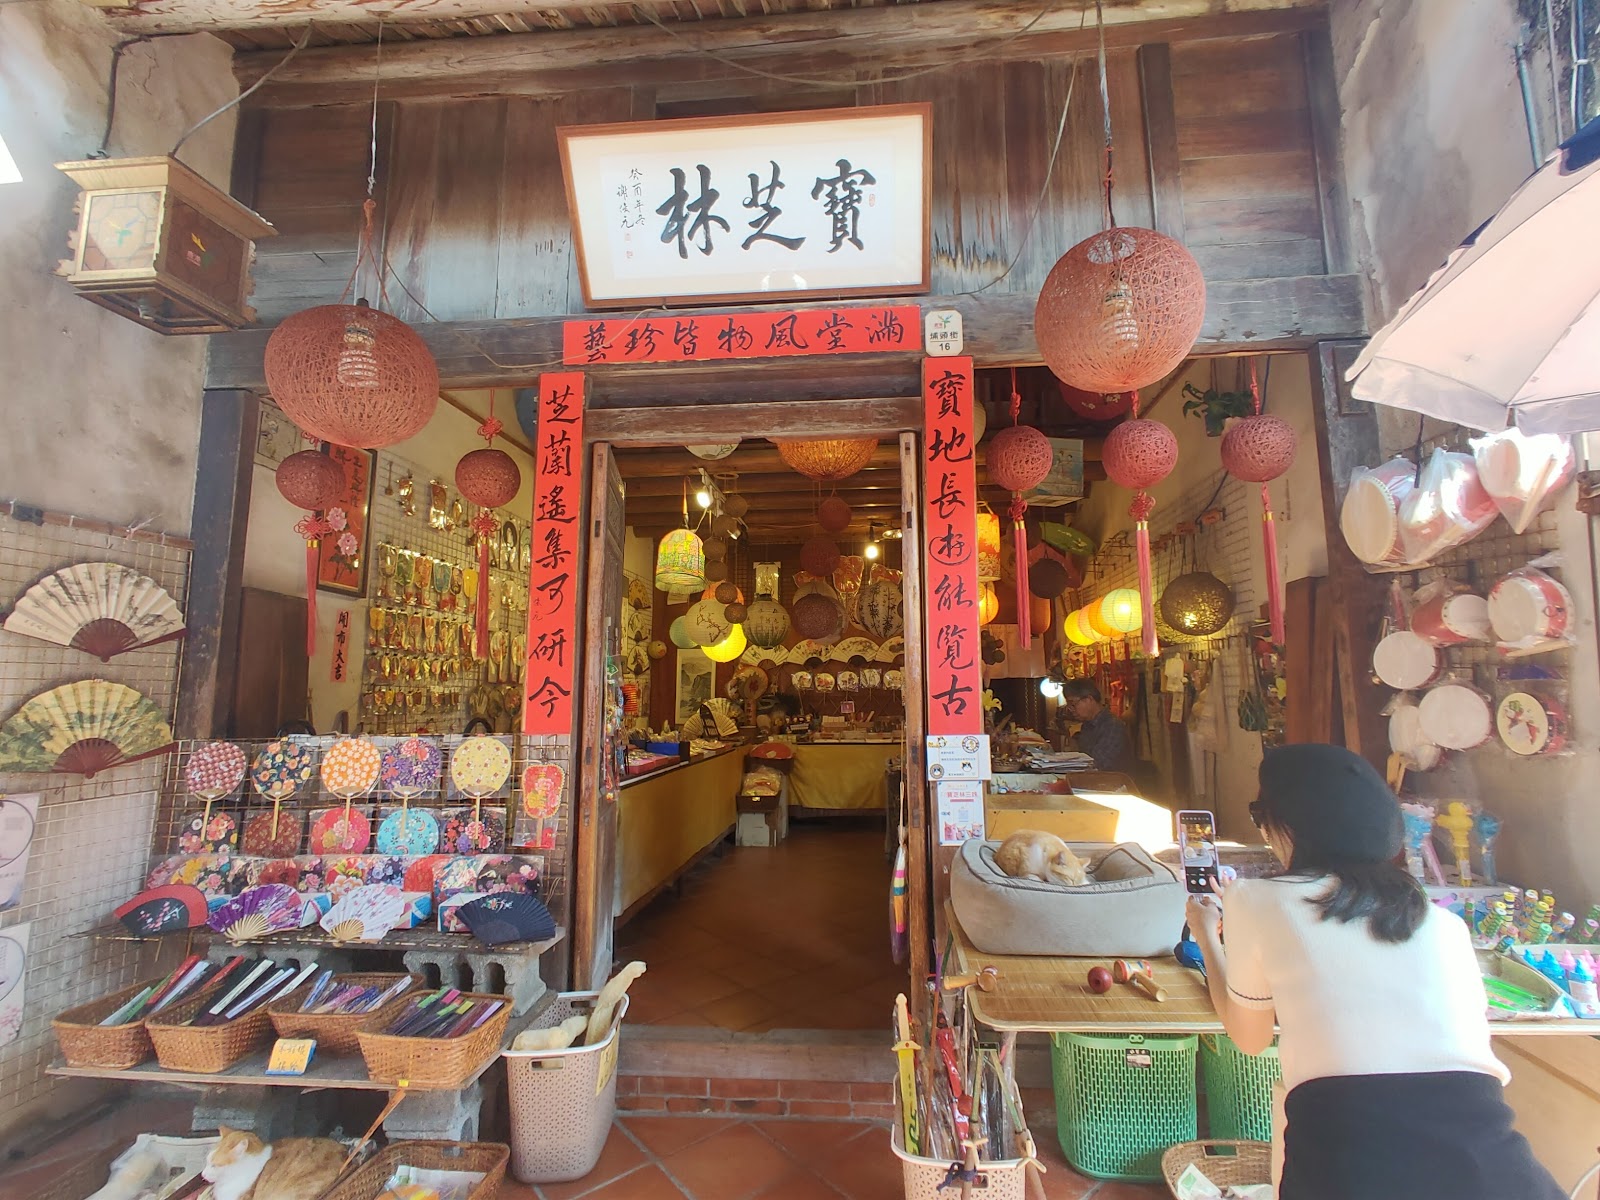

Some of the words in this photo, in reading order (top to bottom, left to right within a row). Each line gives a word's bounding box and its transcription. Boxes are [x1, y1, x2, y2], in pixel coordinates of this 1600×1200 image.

[655, 158, 877, 260] 寶芝林
[929, 331, 959, 340] 埔頭街
[939, 342, 951, 351] 16
[334, 610, 349, 682] 開市大吉
